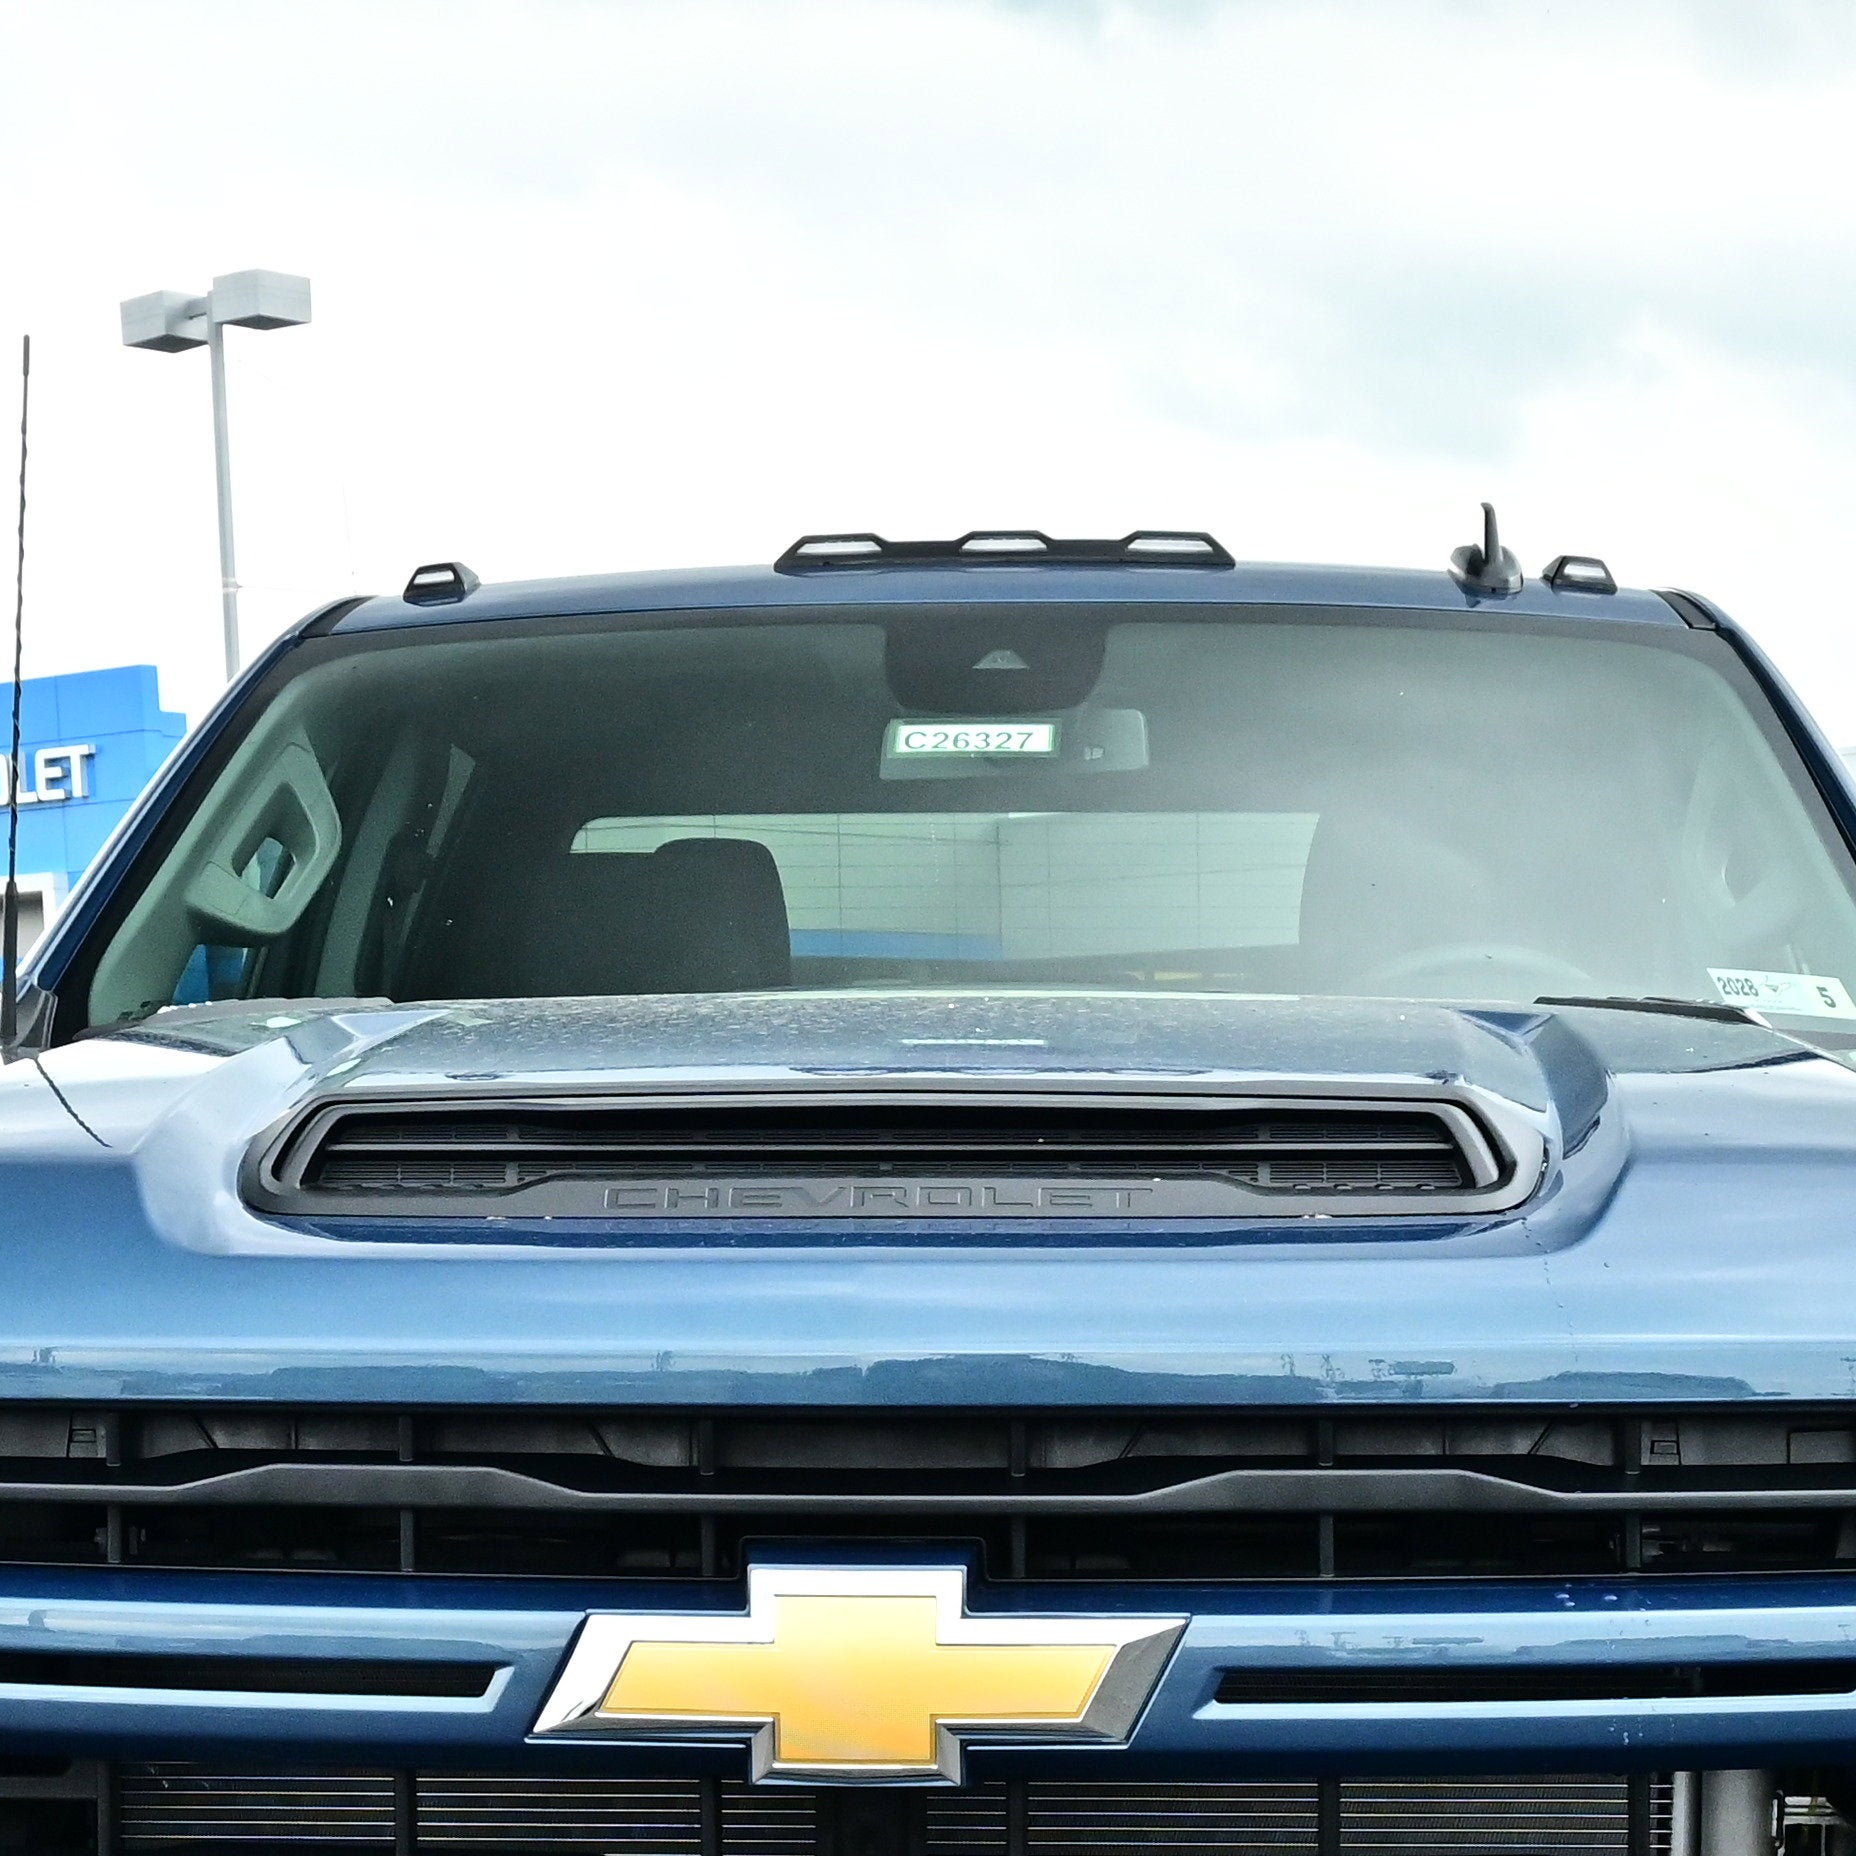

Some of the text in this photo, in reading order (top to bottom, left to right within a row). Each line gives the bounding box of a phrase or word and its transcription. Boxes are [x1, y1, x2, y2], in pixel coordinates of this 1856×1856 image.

[904, 731, 1034, 750] C26327
[1717, 976, 1759, 997] 2028
[1816, 986, 1836, 1008] 5
[604, 1186, 1154, 1208] CHEVROLET
